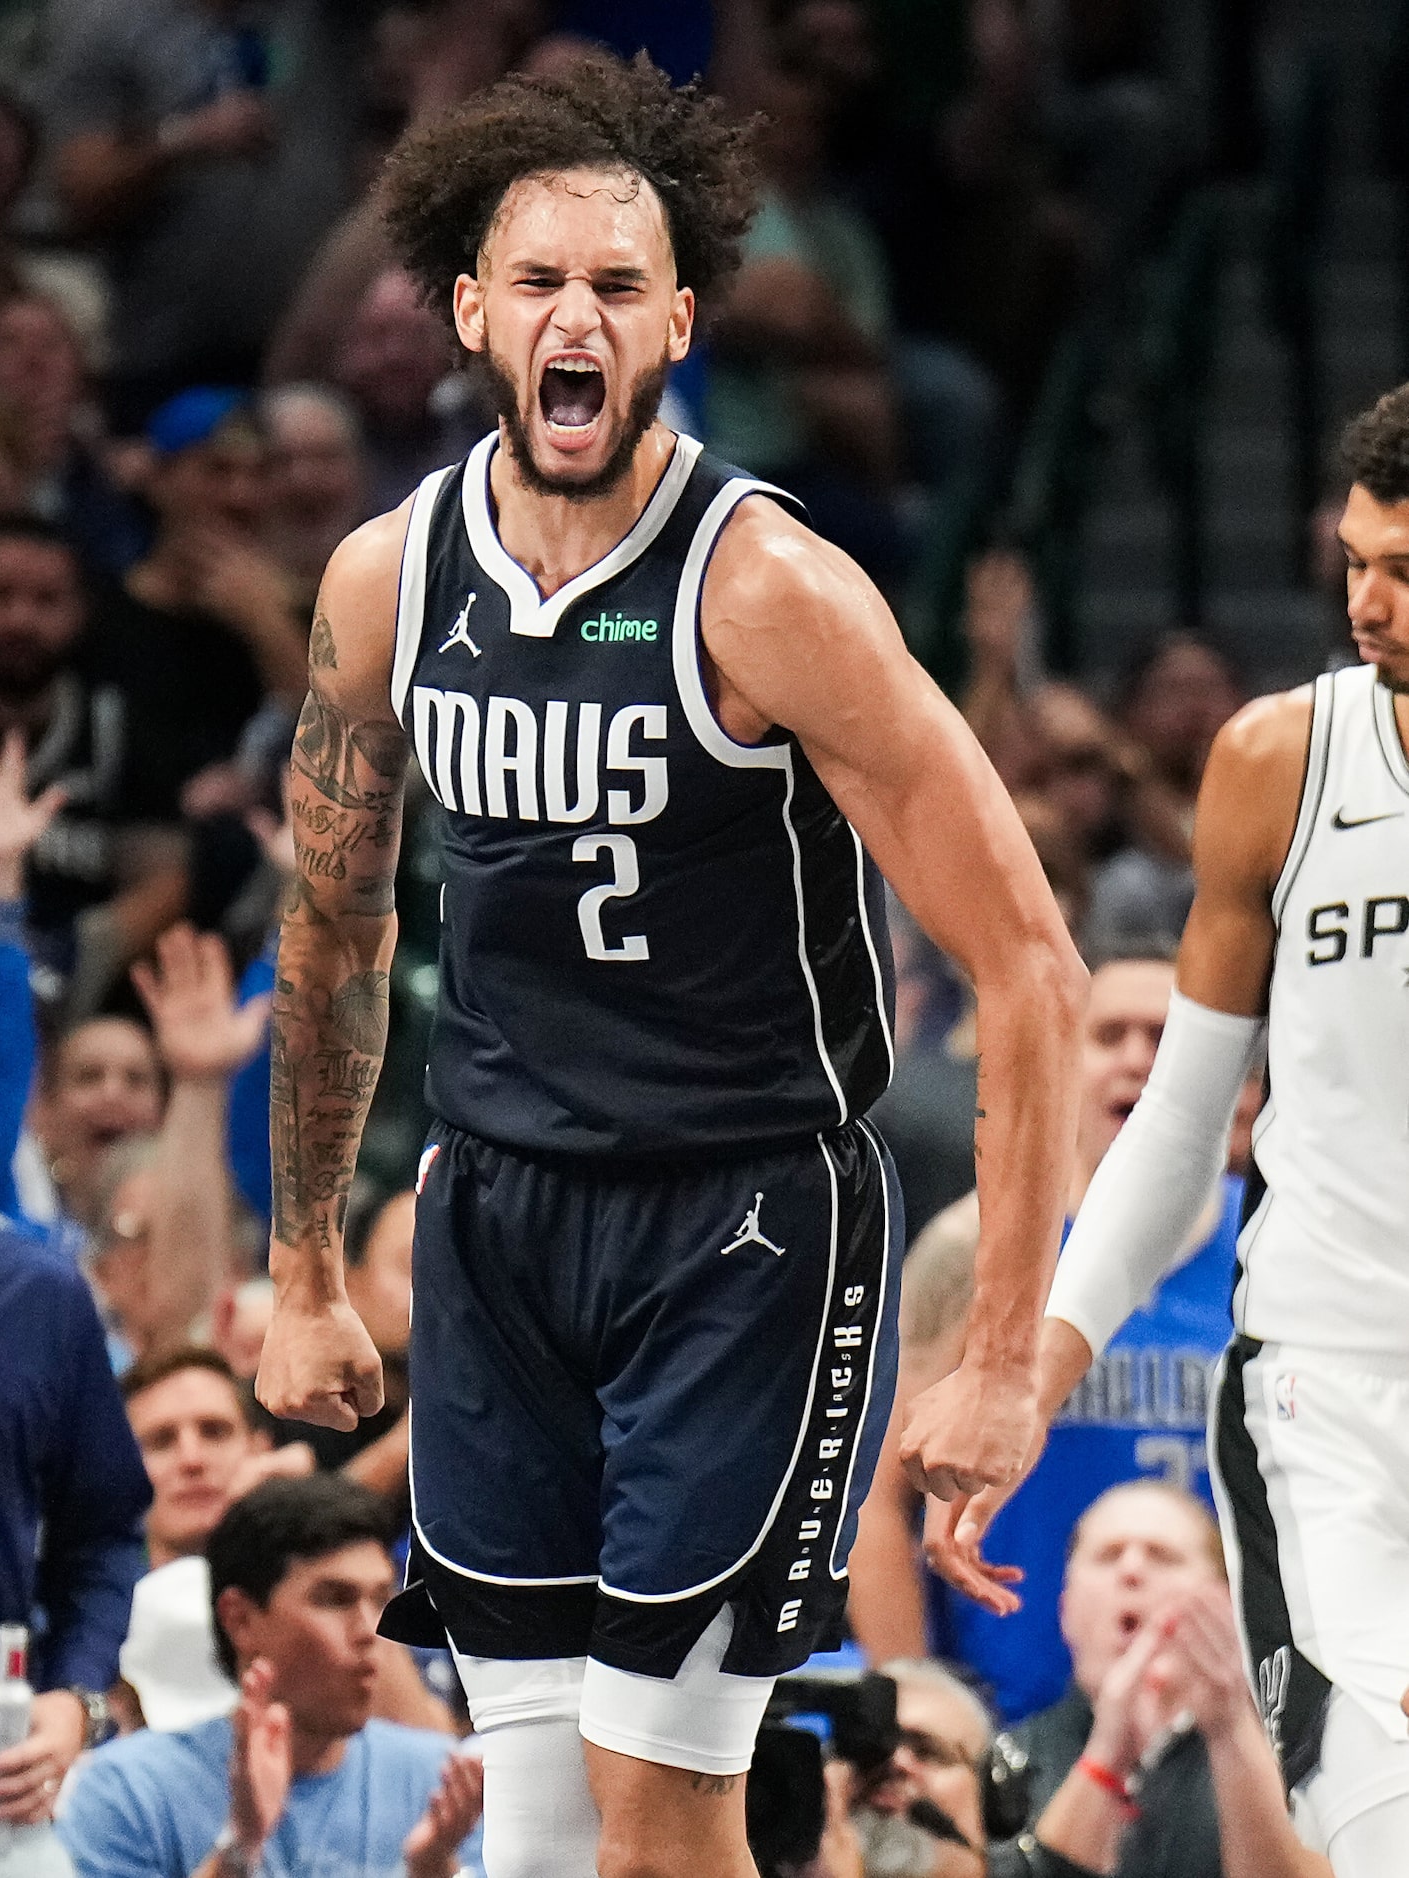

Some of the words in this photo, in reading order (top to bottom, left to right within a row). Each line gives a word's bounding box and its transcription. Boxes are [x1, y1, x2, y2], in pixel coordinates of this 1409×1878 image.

[580, 613, 658, 642] chime
[413, 685, 669, 826] MAVS
[571, 833, 650, 962] 2
[1305, 895, 1409, 968] SP
